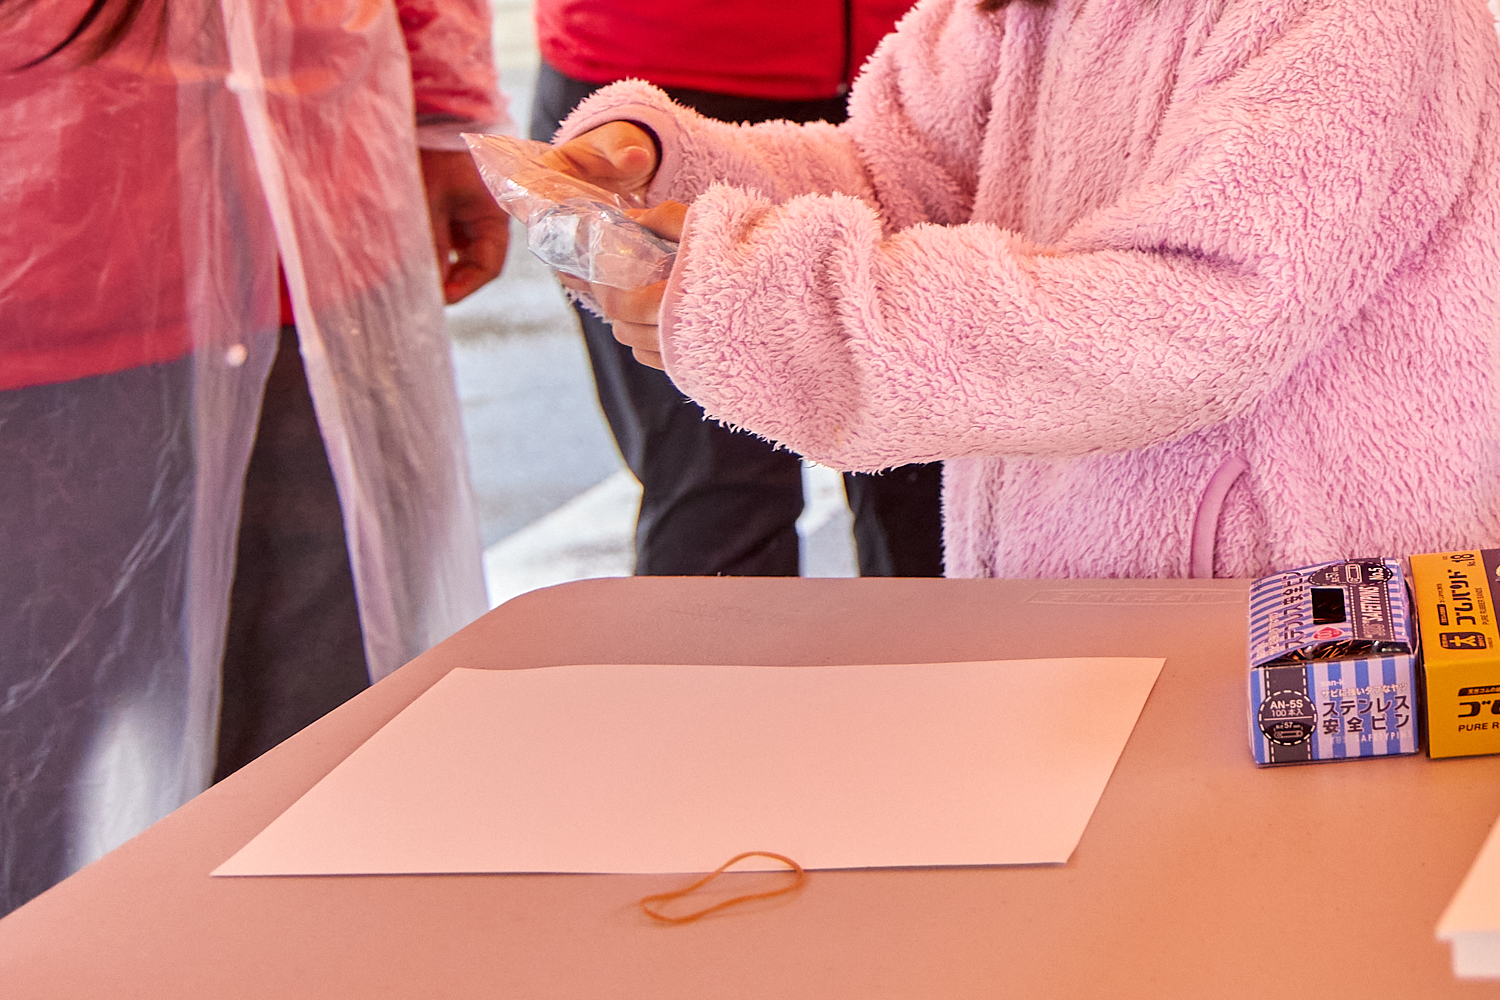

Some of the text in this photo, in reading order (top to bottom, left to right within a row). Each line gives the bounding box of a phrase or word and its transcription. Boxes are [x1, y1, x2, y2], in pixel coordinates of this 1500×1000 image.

[1447, 569, 1476, 626] ゴムバンド
[1270, 699, 1304, 710] AN-5S
[1322, 695, 1411, 718] ステンレス
[1271, 708, 1304, 718] 100本入
[1322, 714, 1410, 735] 安全ピン
[1458, 722, 1489, 732] PURE
